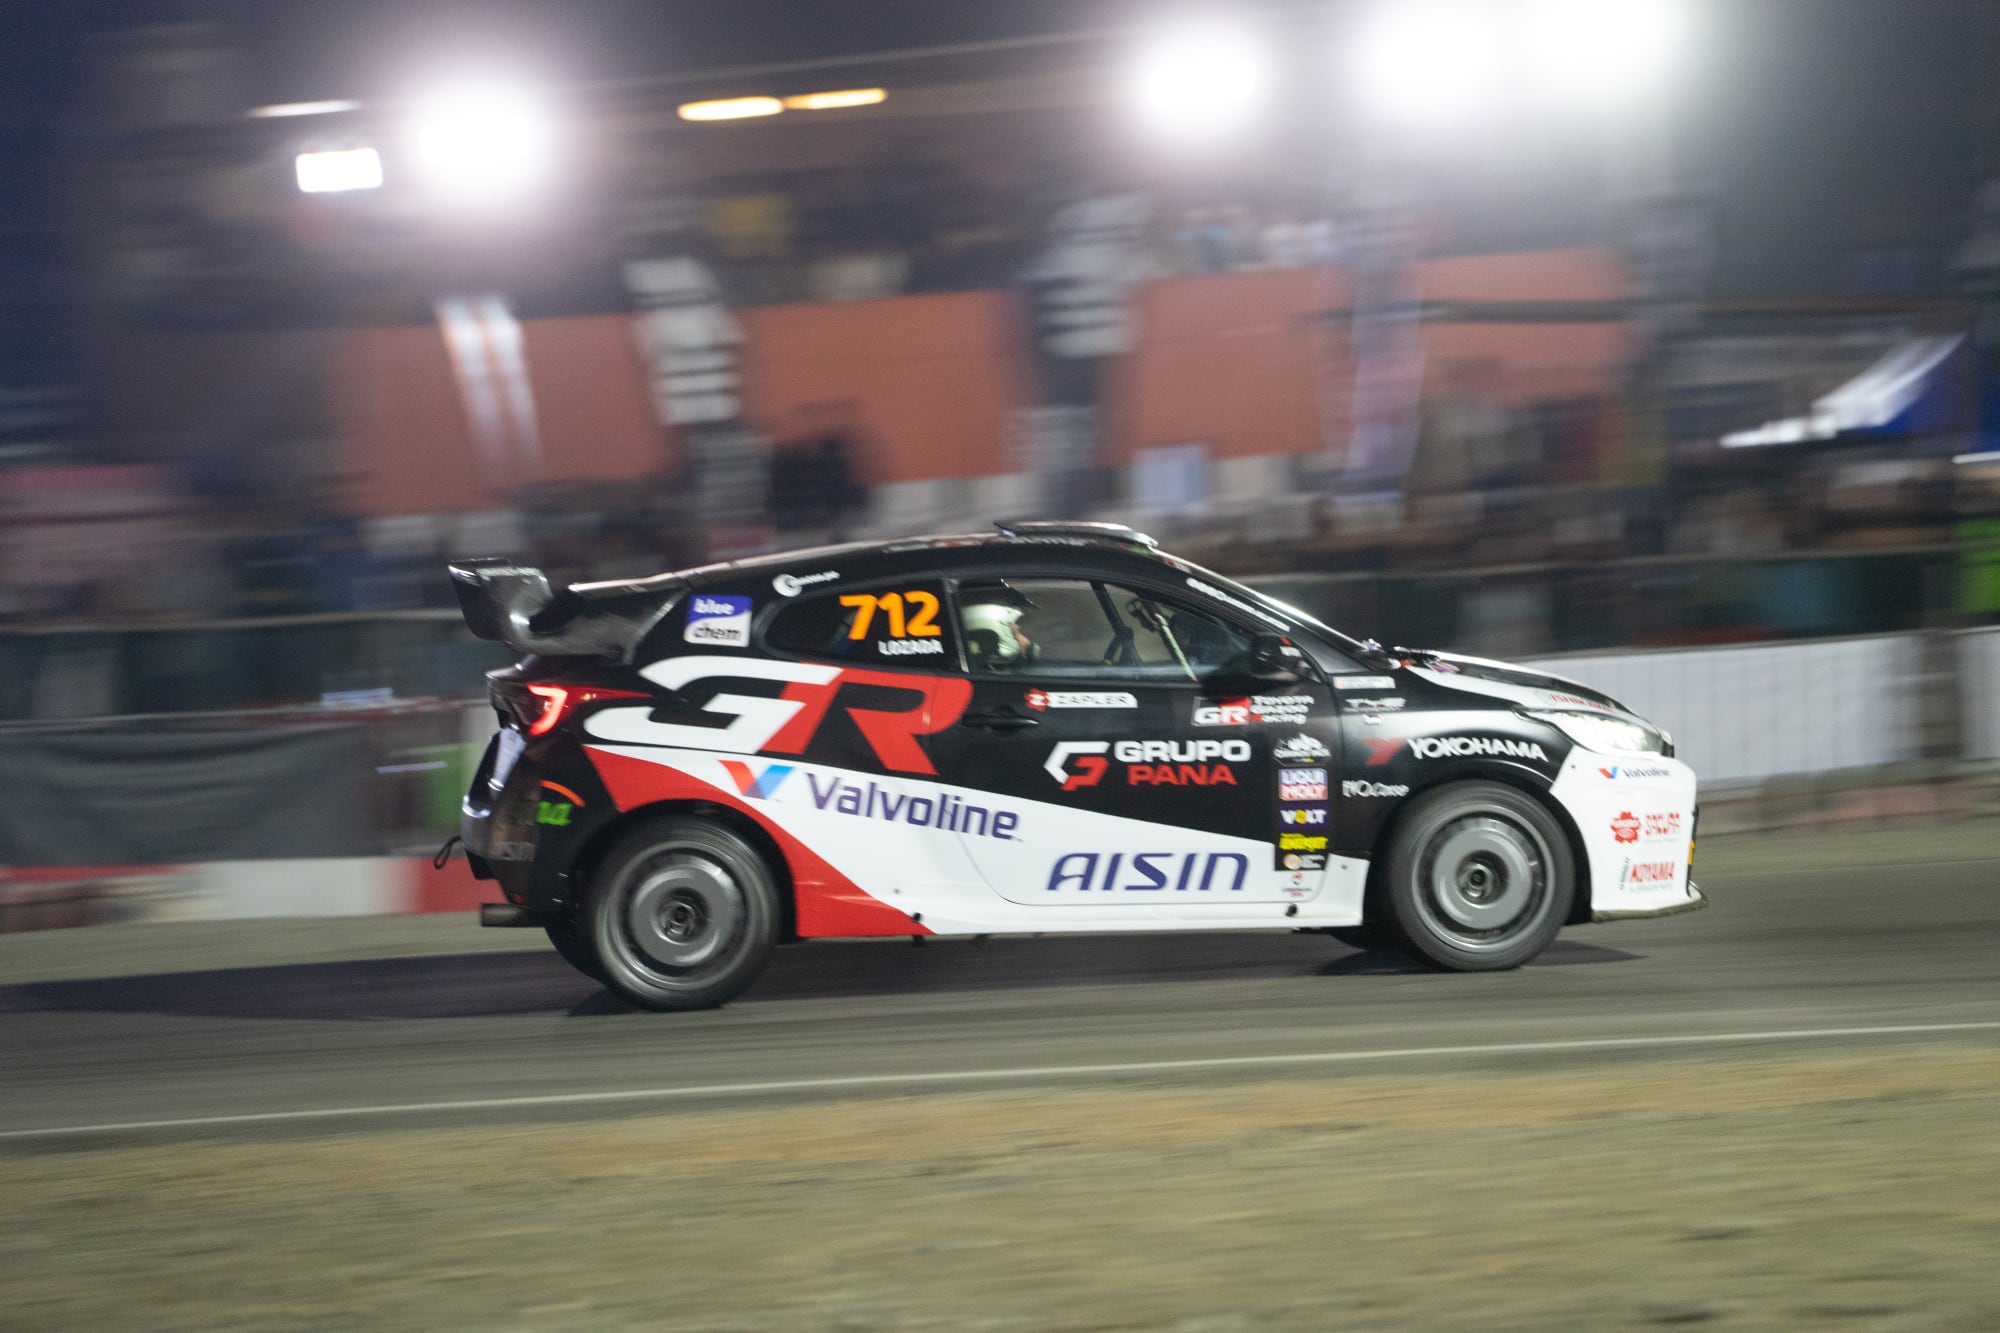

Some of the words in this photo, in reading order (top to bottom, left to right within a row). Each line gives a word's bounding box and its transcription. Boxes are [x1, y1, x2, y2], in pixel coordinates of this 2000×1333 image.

[693, 598, 735, 616] blue
[838, 590, 942, 640] 712
[693, 621, 742, 641] chem
[878, 639, 944, 656] LOZADA
[583, 655, 973, 775] GR
[1194, 706, 1249, 724] GR
[1114, 740, 1251, 762] GRUPO
[1407, 737, 1550, 763] YOKOHAMA
[1127, 764, 1238, 786] PANA
[1280, 769, 1326, 785] LIQUI
[1622, 767, 1671, 778] Valvoline
[1281, 784, 1327, 800] MOLY
[805, 772, 1019, 841] Valvoline
[1280, 809, 1327, 824] VOLT
[1046, 853, 1249, 891] AISIN
